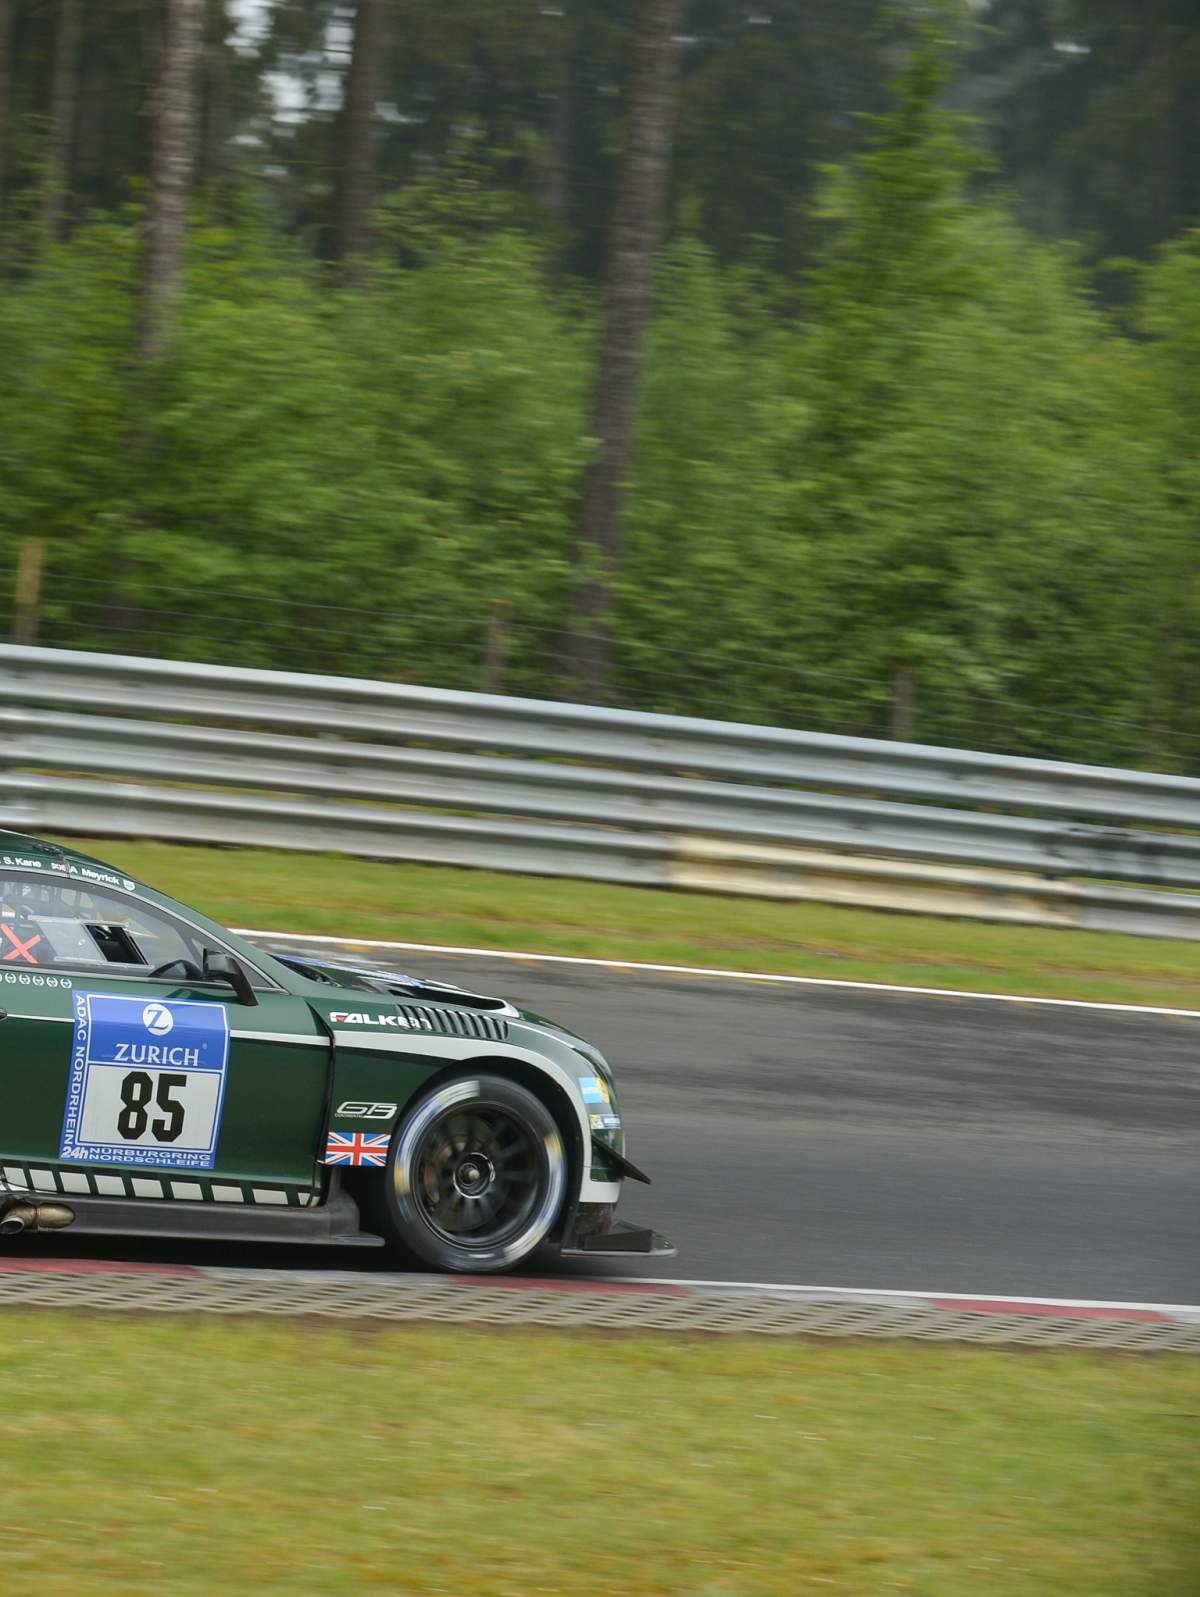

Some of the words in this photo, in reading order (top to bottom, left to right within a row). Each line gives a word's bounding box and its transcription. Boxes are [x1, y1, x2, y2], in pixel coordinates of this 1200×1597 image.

[3, 857, 14, 865] S.
[15, 857, 42, 868] Kane
[81, 868, 120, 886] Meyrick
[75, 994, 87, 1041] ADAC
[330, 1011, 433, 1031] FALKEN
[113, 1043, 200, 1067] ZURICH
[63, 1046, 86, 1145] NORDRHEIN
[117, 1071, 187, 1142] 85
[61, 1146, 88, 1160] 24h
[89, 1146, 211, 1161] NÜRBURGRING
[89, 1153, 210, 1168] NORDSCHLEIFE
